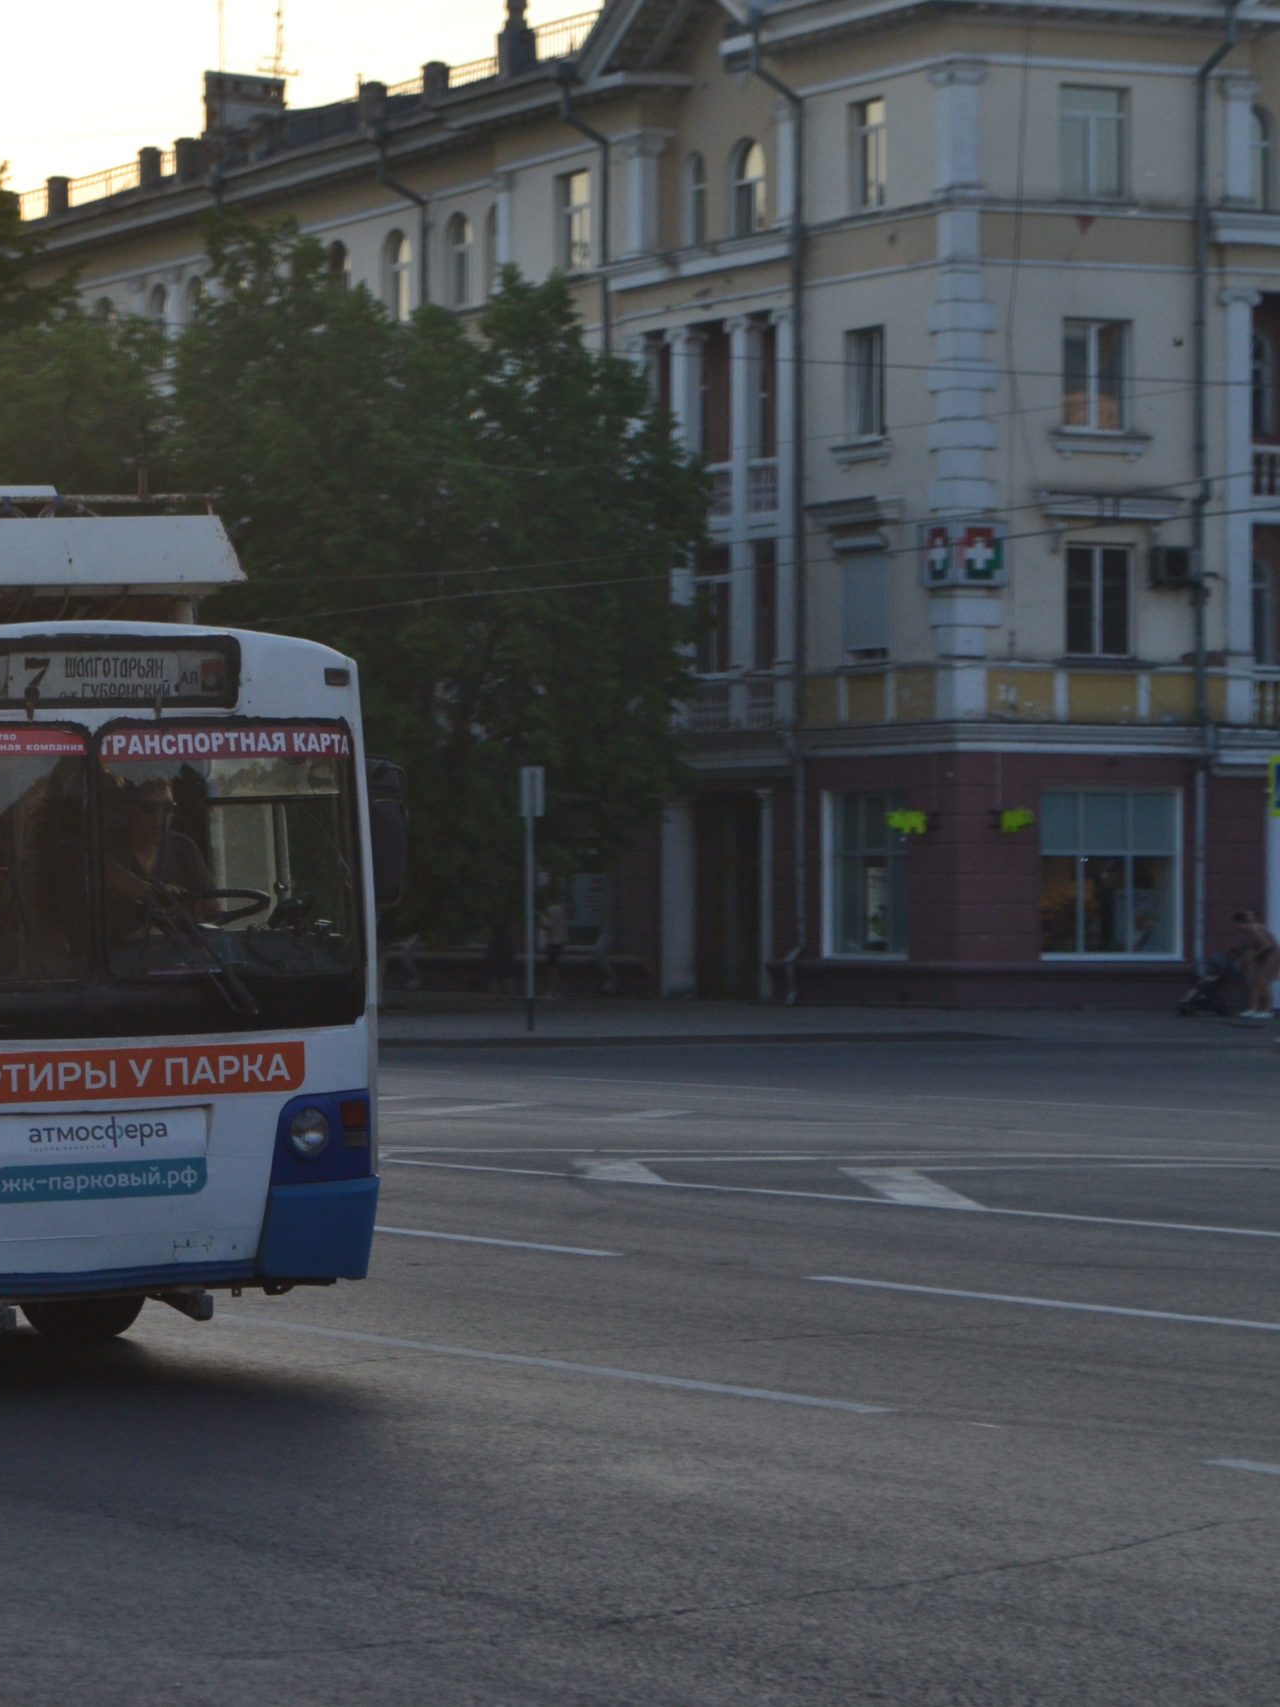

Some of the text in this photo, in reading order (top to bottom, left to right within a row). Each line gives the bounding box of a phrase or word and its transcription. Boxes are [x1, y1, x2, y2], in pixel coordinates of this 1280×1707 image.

[24, 657, 50, 699] 7
[64, 657, 163, 679] ШАЛГОТАРЬЯН
[26, 743, 84, 752] компания
[293, 732, 350, 755] КАРТА
[128, 1058, 153, 1088] У
[164, 1053, 291, 1087] ПАРКА
[29, 1116, 168, 1148] атмосфера
[1, 1165, 198, 1193] жк-парковый.рф
